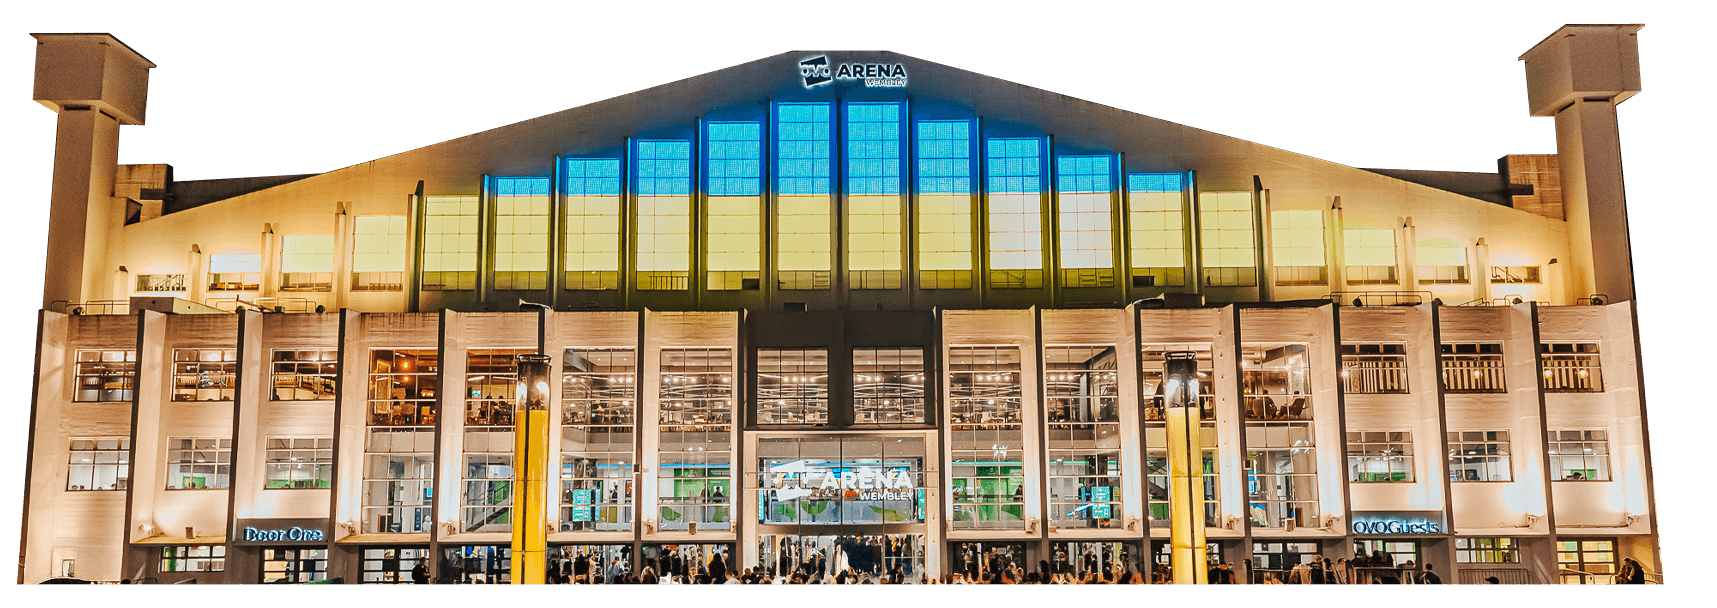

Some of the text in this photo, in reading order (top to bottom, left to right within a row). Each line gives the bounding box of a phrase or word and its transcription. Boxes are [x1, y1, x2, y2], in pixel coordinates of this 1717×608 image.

[836, 63, 907, 79] ARENA
[866, 79, 907, 87] WEMBLEY
[819, 470, 914, 490] ARENA
[859, 490, 914, 501] WEMBLEY
[244, 526, 324, 542] Door One
